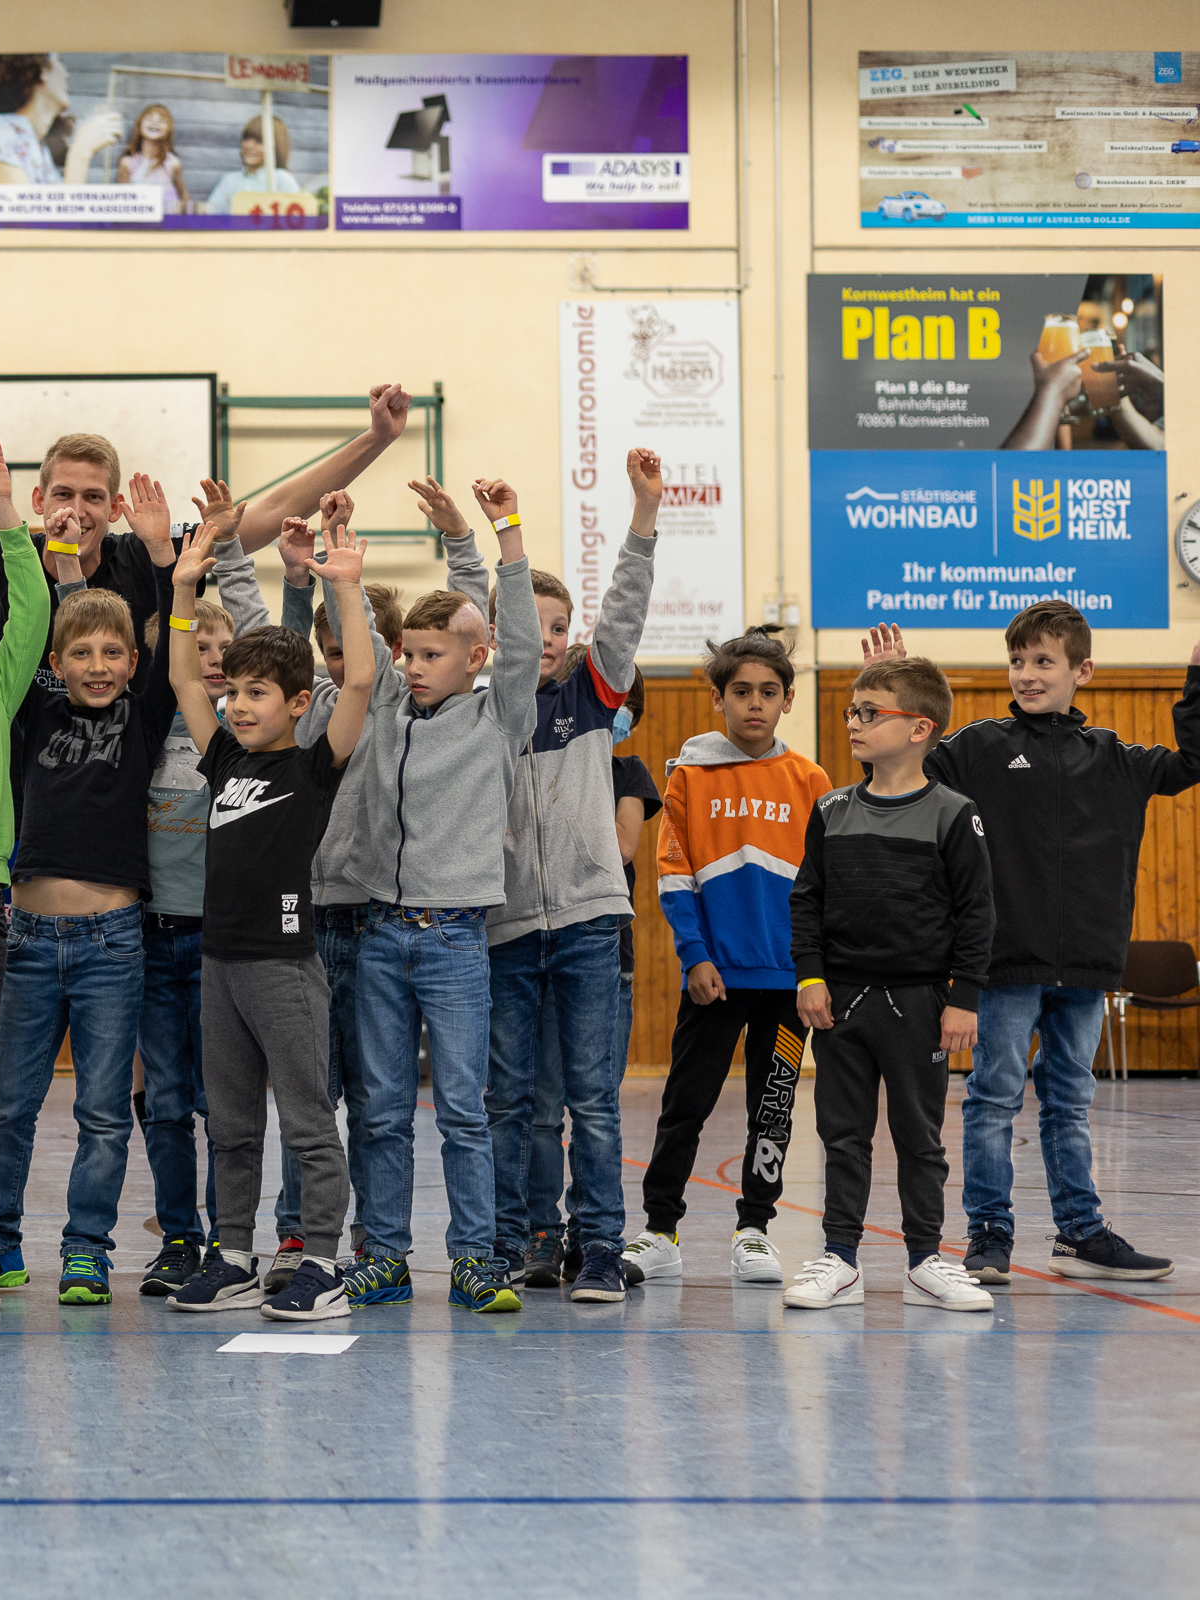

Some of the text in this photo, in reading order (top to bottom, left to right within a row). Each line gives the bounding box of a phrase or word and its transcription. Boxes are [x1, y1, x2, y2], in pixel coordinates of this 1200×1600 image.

[913, 70, 940, 79] DEIN
[945, 65, 1009, 77] WEGWEISER
[1158, 67, 1175, 75] ZEG
[870, 79, 1000, 95] DURCH DIE AUSBILDUNG
[599, 160, 672, 176] ADASYS
[842, 287, 1000, 301] Kornwestheim hat ein
[842, 306, 1001, 360] Plan B
[652, 364, 713, 380] Hasen
[875, 380, 970, 394] Plan B die Bar
[572, 305, 597, 491] Gastronomie
[877, 396, 968, 412] Bahnhofsplatz
[857, 413, 990, 427] 70806 Kornwestheim
[660, 463, 720, 484] OTEL
[660, 486, 720, 505] MIZIL
[900, 487, 977, 503] STÄDTISCHE
[1068, 479, 1131, 499] KORN
[846, 505, 977, 529] WOHNBAU
[1068, 500, 1131, 519] WEST
[1068, 520, 1132, 540] HEIM.
[902, 563, 1076, 582] Ihr kommunaler
[867, 590, 948, 610] Partner
[952, 590, 985, 610] für
[215, 777, 272, 807] NIKE
[710, 797, 791, 823] PLAYER
[282, 899, 298, 911] 97
